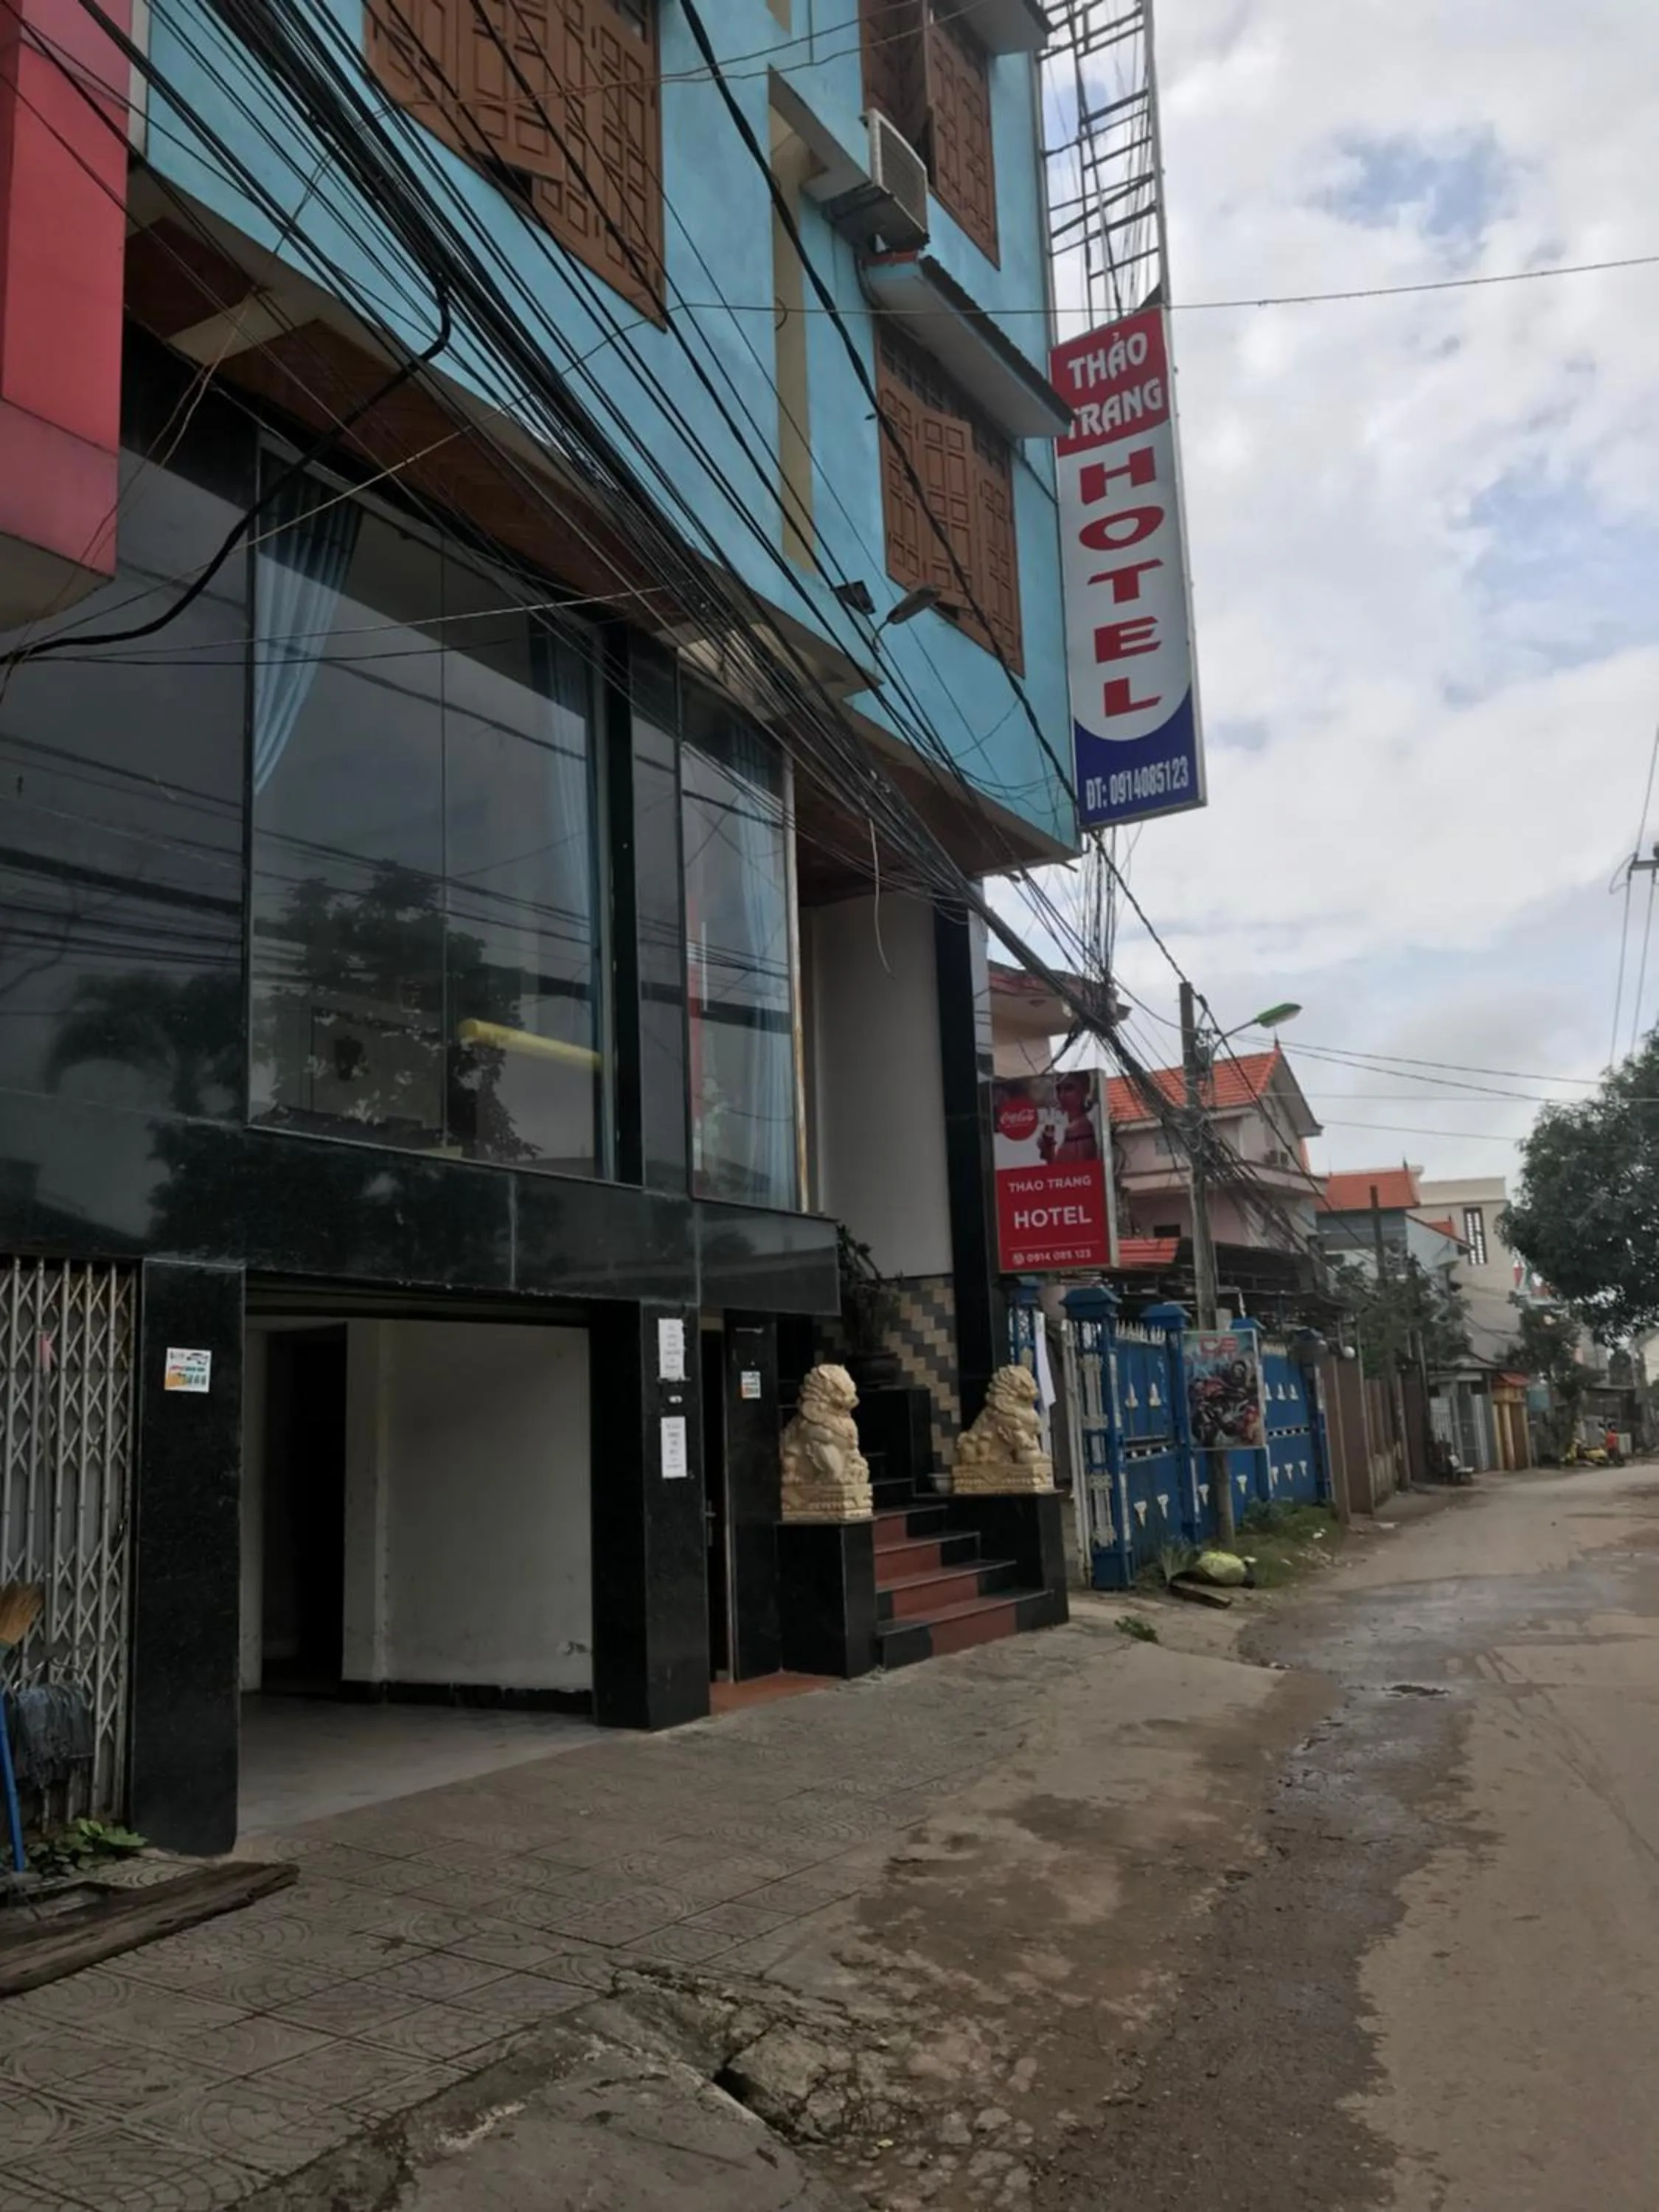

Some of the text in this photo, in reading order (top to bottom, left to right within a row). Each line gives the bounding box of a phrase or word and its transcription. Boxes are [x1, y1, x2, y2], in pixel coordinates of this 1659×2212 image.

[1068, 331, 1148, 389] THẢO
[1079, 445, 1165, 718] HOTEL
[1110, 755, 1189, 804] 0914085123
[1047, 1175, 1092, 1189] TRANG
[1014, 1205, 1093, 1229] HOTEL
